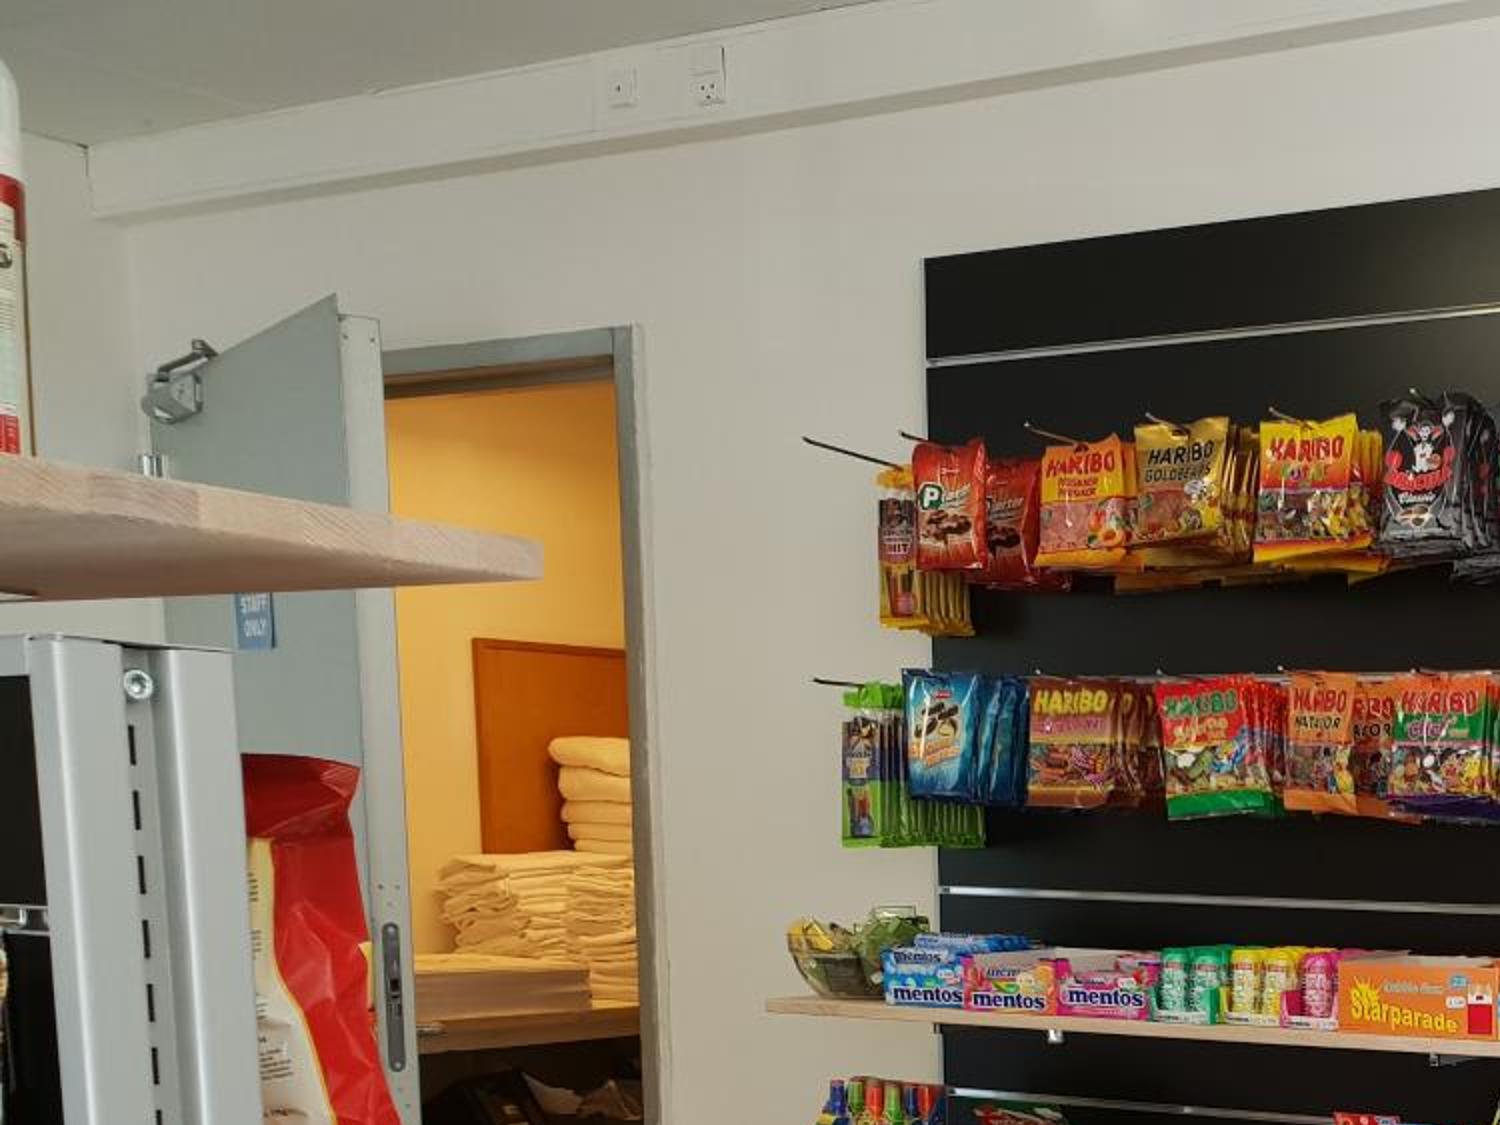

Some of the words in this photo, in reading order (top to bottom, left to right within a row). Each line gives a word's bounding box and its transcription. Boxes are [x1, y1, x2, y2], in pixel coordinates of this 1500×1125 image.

[1045, 450, 1115, 478] HARIBO
[1149, 439, 1215, 464] HARIBO
[1035, 689, 1108, 714] HARIBO
[1402, 689, 1480, 714] HARIBO
[893, 987, 963, 1003] mentos
[973, 993, 1046, 1010] mentos
[1067, 987, 1144, 1007] mentos
